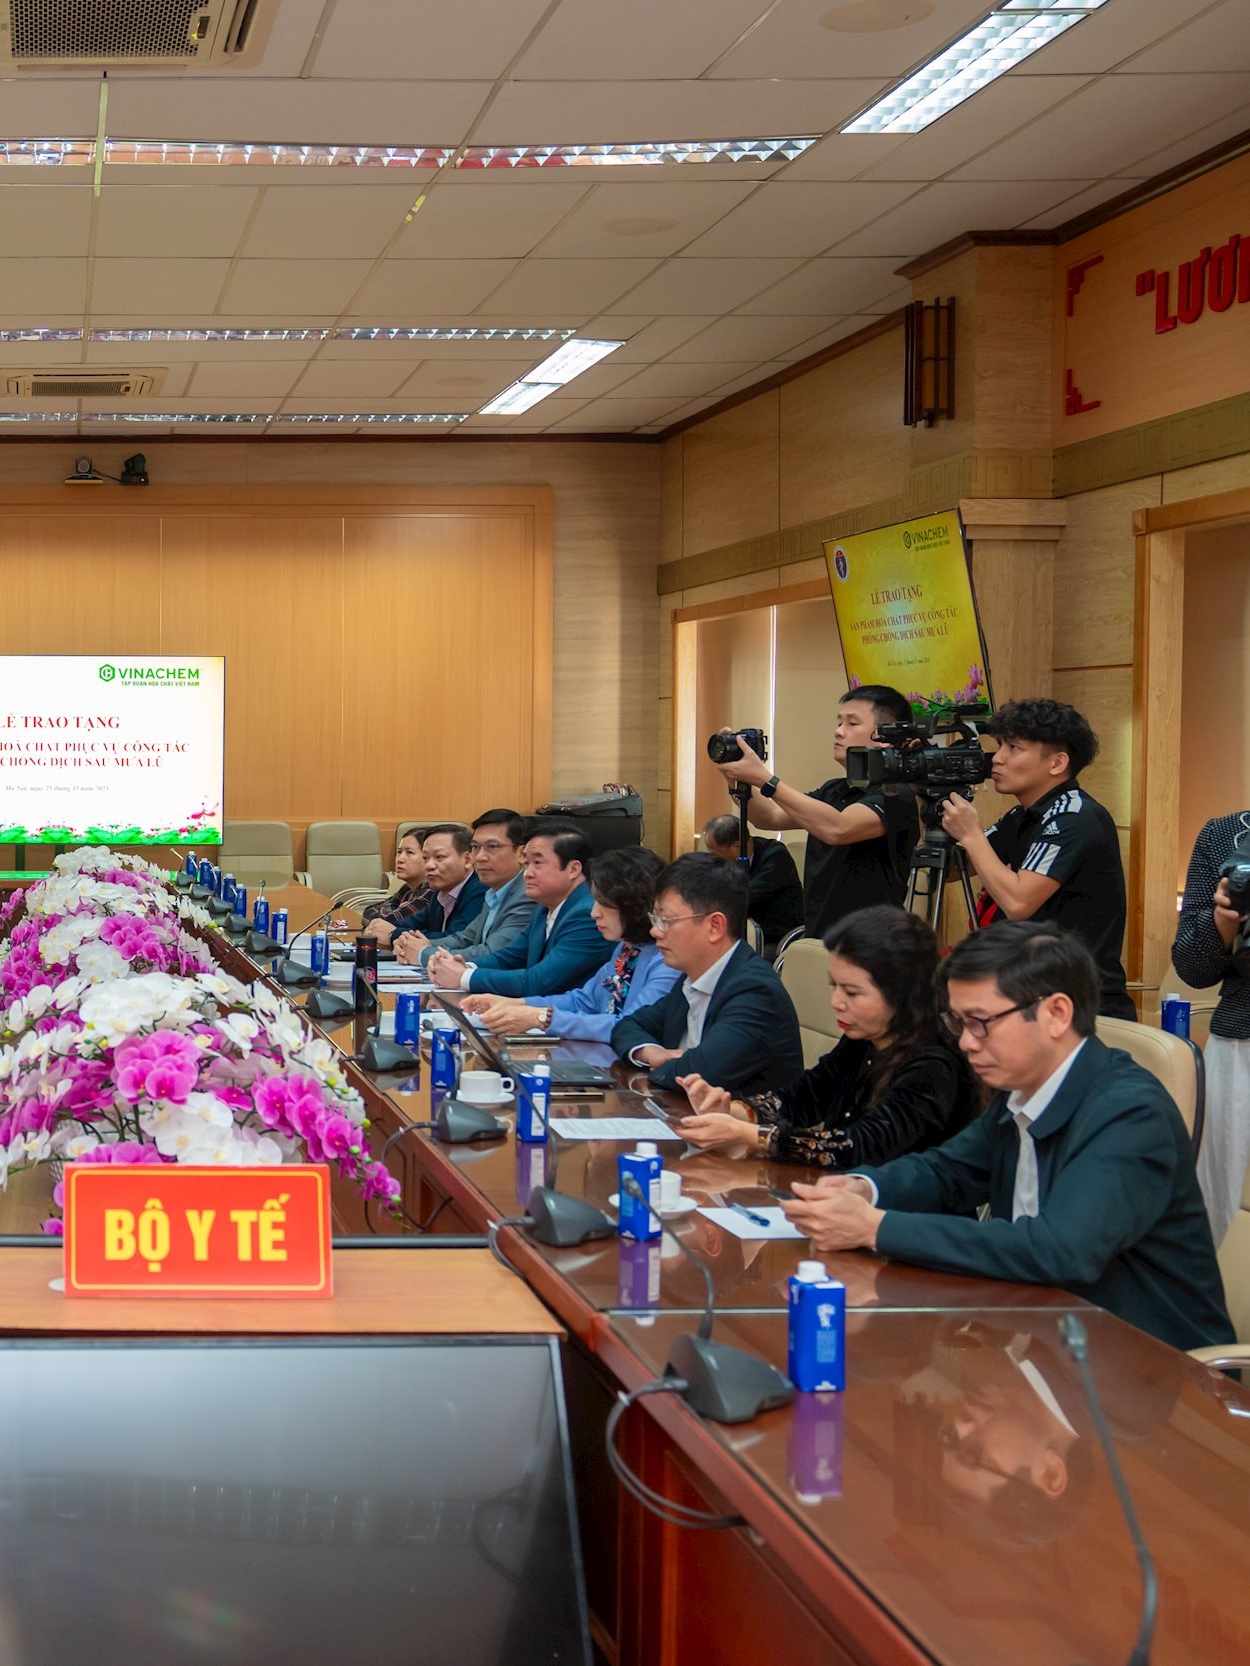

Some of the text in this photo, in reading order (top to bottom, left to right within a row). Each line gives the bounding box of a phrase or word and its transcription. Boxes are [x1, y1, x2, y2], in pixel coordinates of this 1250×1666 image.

[911, 525, 949, 545] VINACHEM
[118, 668, 200, 679] VINACHEM
[20, 715, 69, 729] TRAO
[104, 1193, 290, 1273] BỘ Y TẾ
